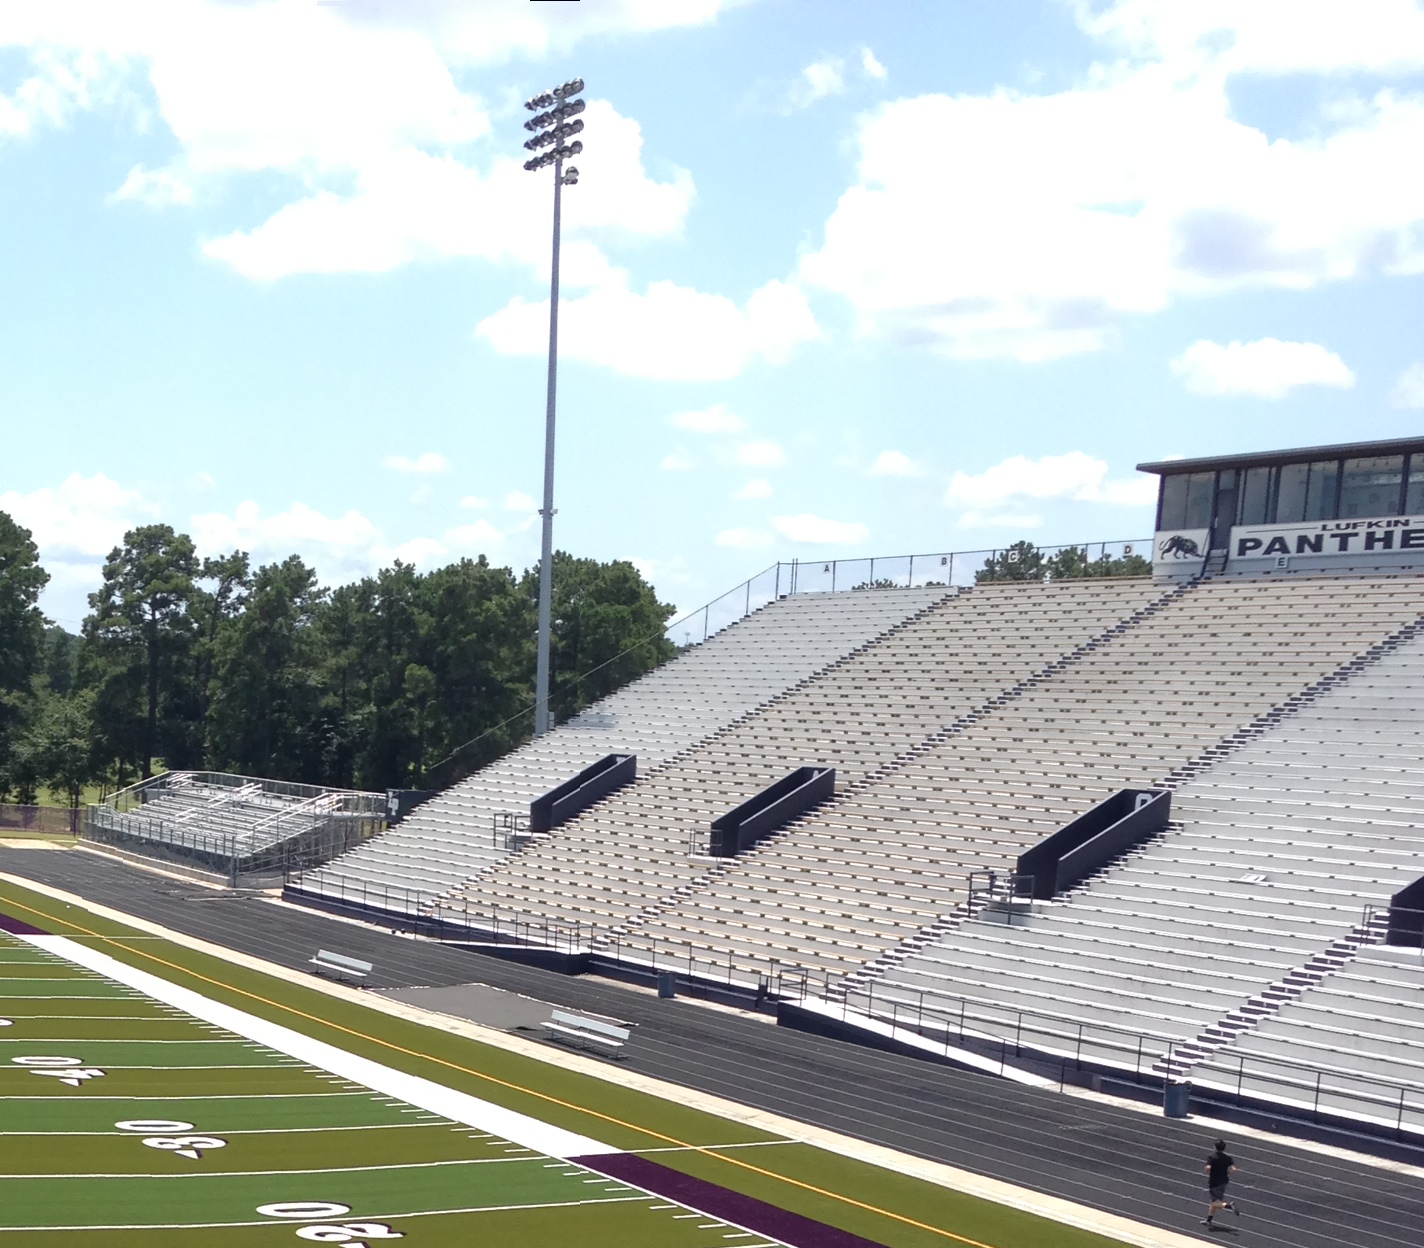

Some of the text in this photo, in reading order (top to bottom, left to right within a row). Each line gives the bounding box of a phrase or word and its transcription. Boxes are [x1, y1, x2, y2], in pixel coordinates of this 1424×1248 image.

[1321, 519, 1410, 531] LUFKIN
[1009, 551, 1018, 562] C
[1277, 557, 1286, 567] E
[114, 1119, 228, 1150] 30
[255, 1201, 407, 1242] 20
